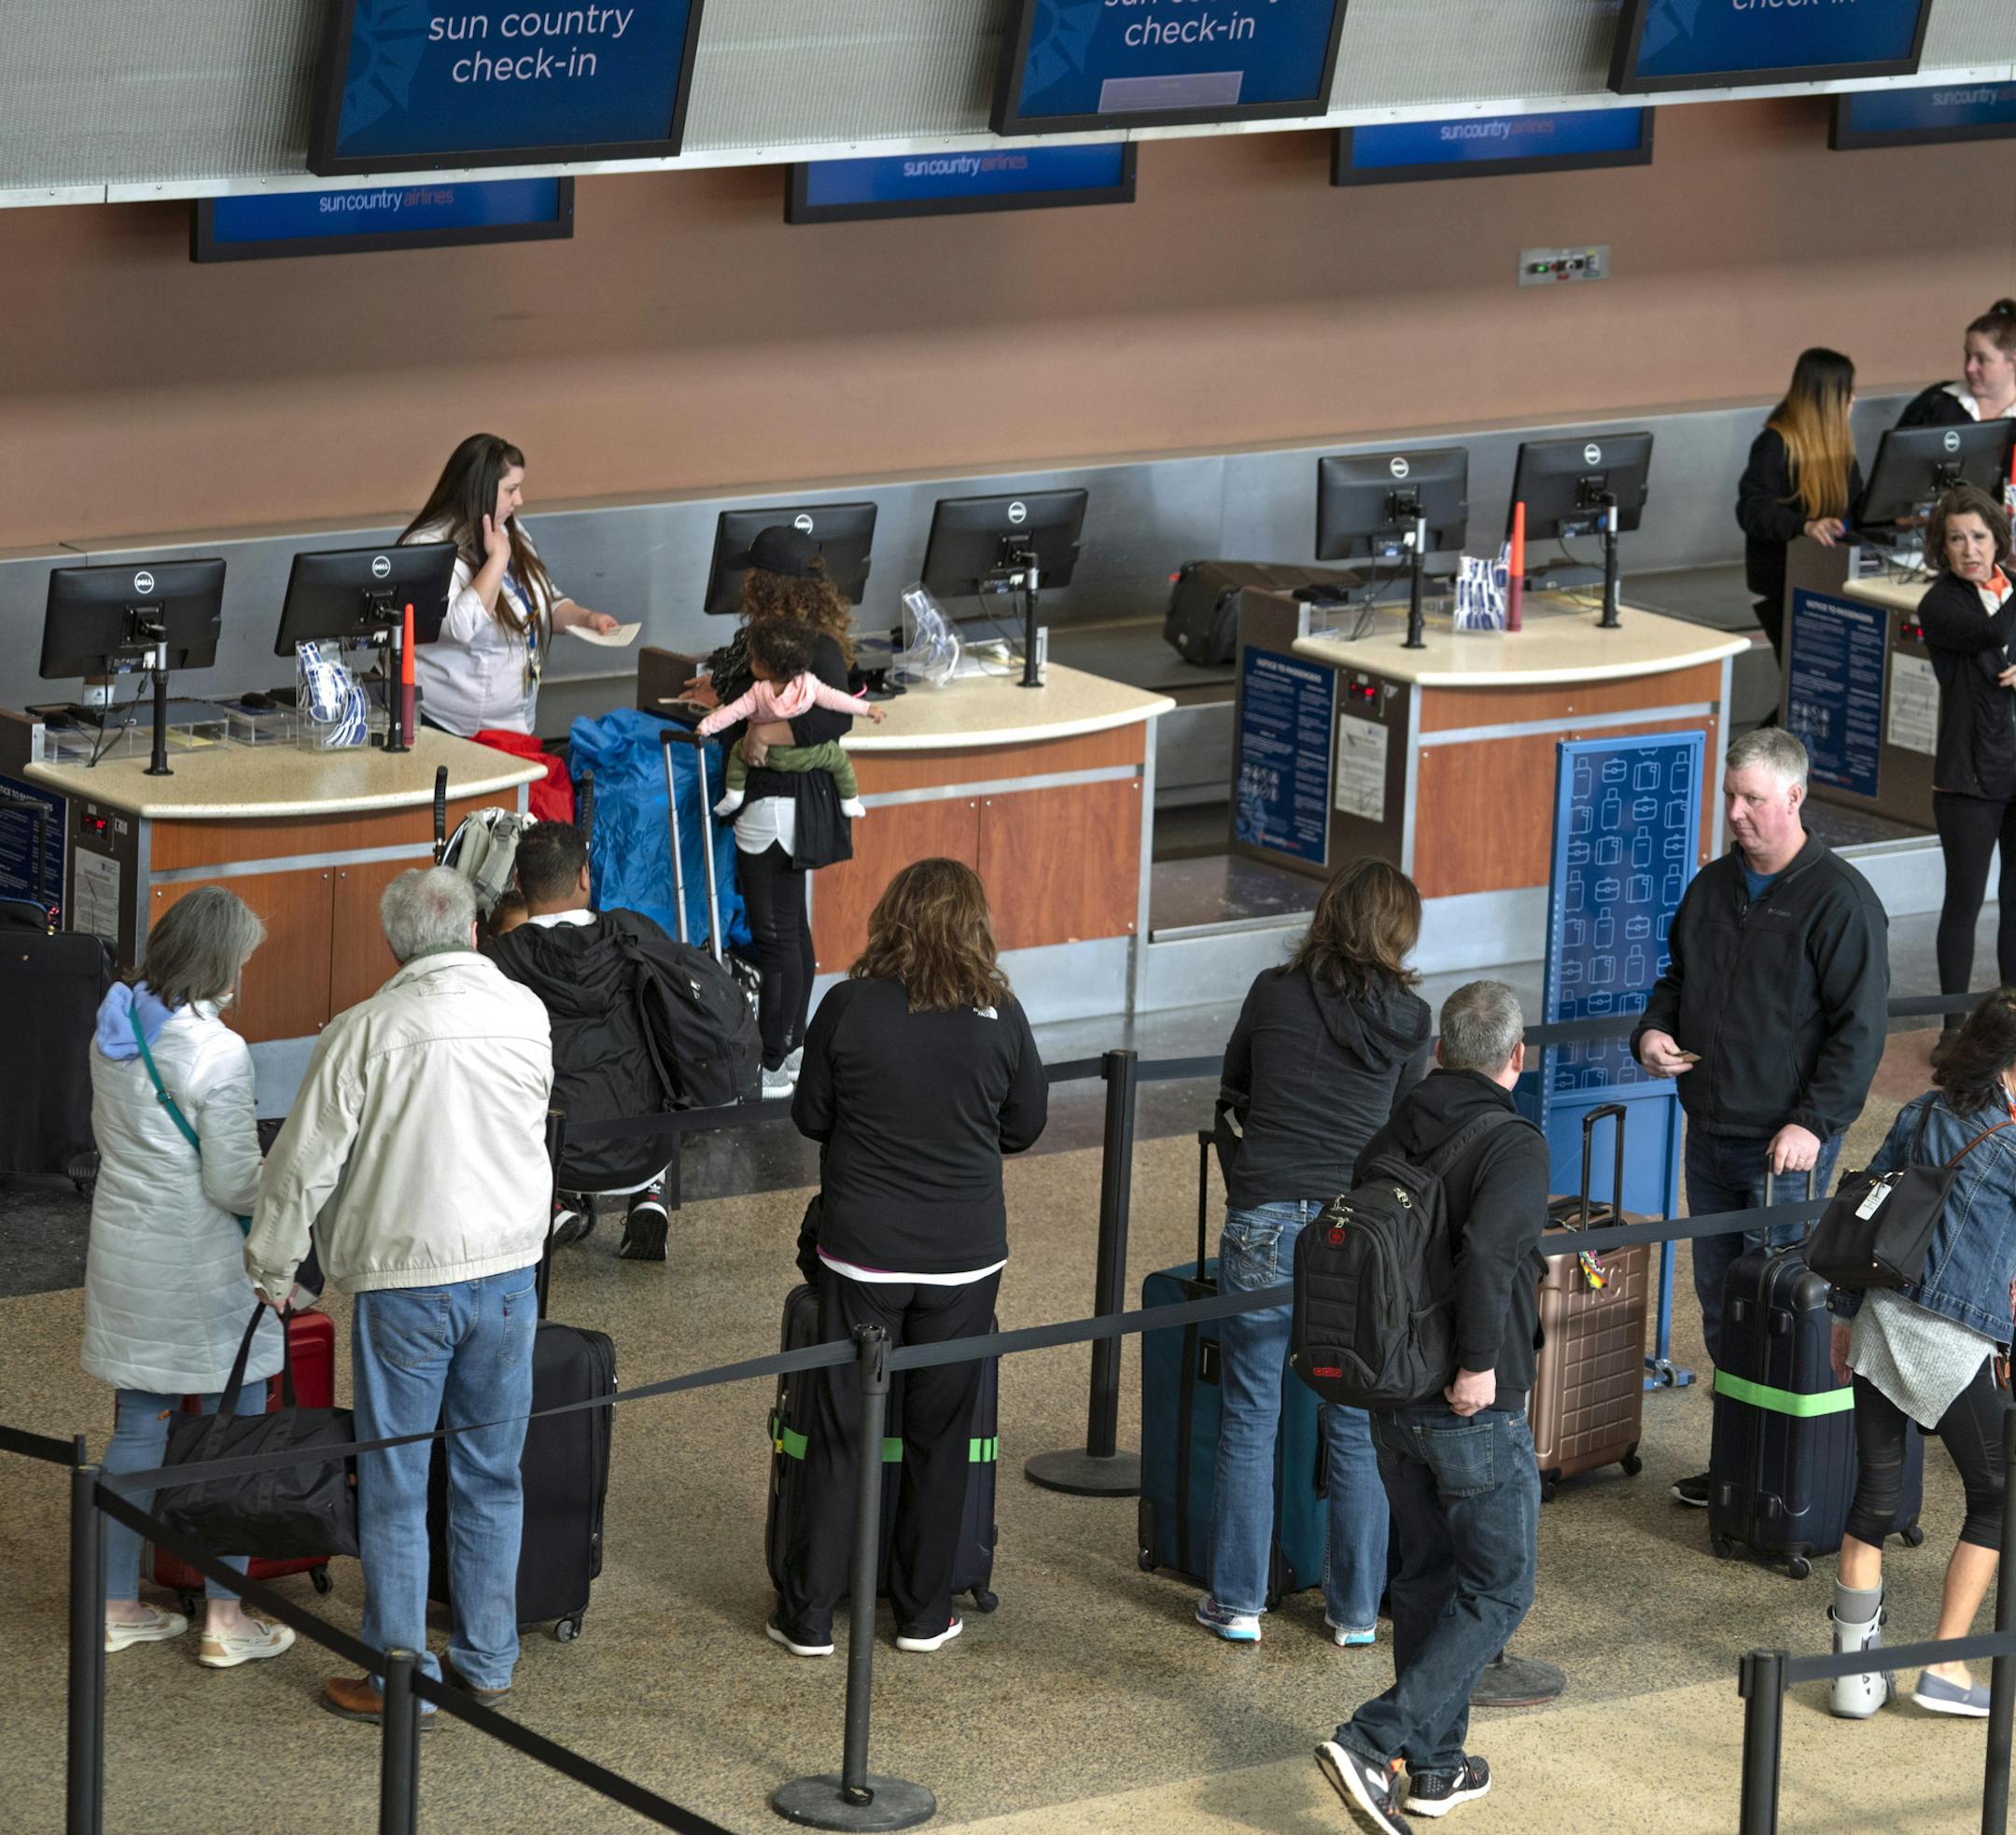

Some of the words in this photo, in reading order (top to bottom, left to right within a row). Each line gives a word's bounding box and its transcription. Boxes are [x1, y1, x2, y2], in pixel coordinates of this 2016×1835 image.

[428, 15, 488, 41] sun
[500, 4, 635, 38] country
[1125, 11, 1255, 46] check-in
[452, 47, 597, 83] check-in
[403, 189, 455, 207] airlines
